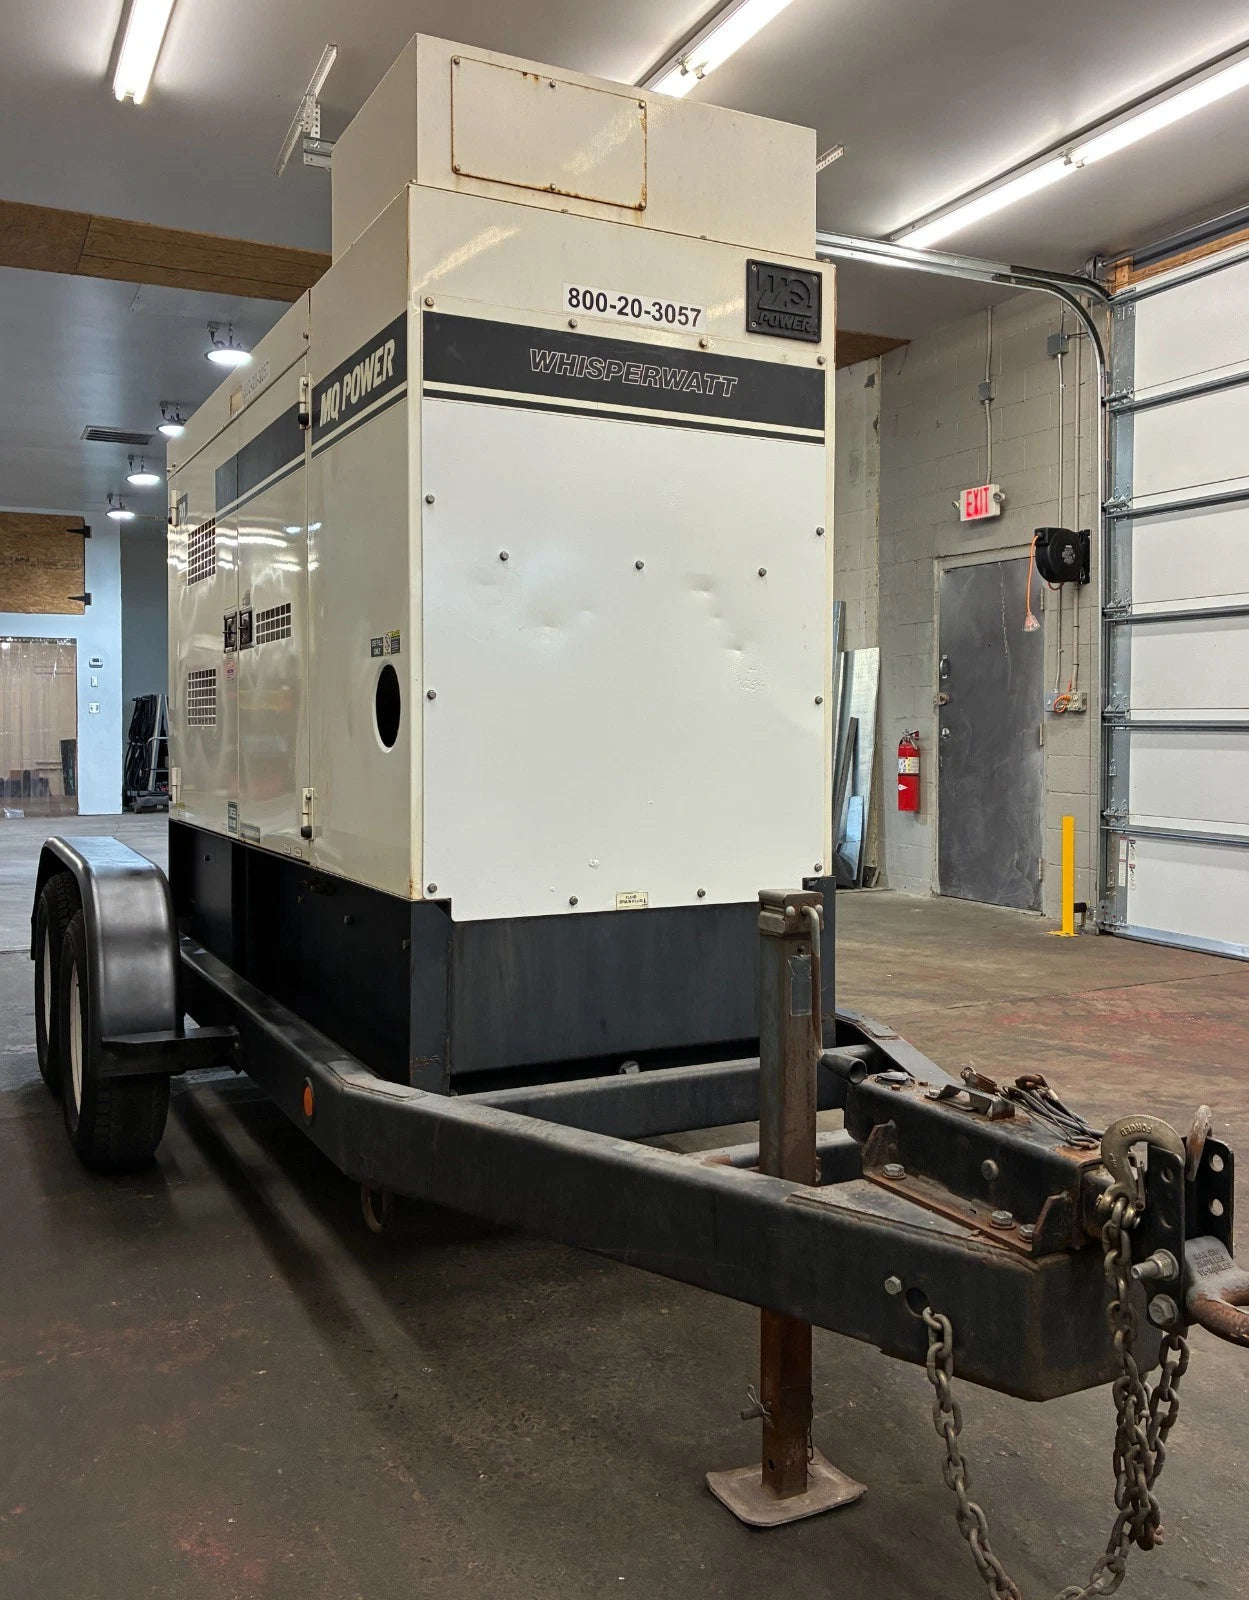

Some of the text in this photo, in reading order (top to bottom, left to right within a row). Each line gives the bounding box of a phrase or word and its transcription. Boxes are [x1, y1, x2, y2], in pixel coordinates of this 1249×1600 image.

[568, 287, 702, 328] 800-20-3057
[757, 311, 811, 334] POWER
[320, 382, 341, 428] MQ
[341, 338, 395, 411] POWER
[528, 349, 738, 397] WHISPERWATT
[965, 486, 989, 519] EXIT
[1121, 1122, 1153, 1136] FORGED
